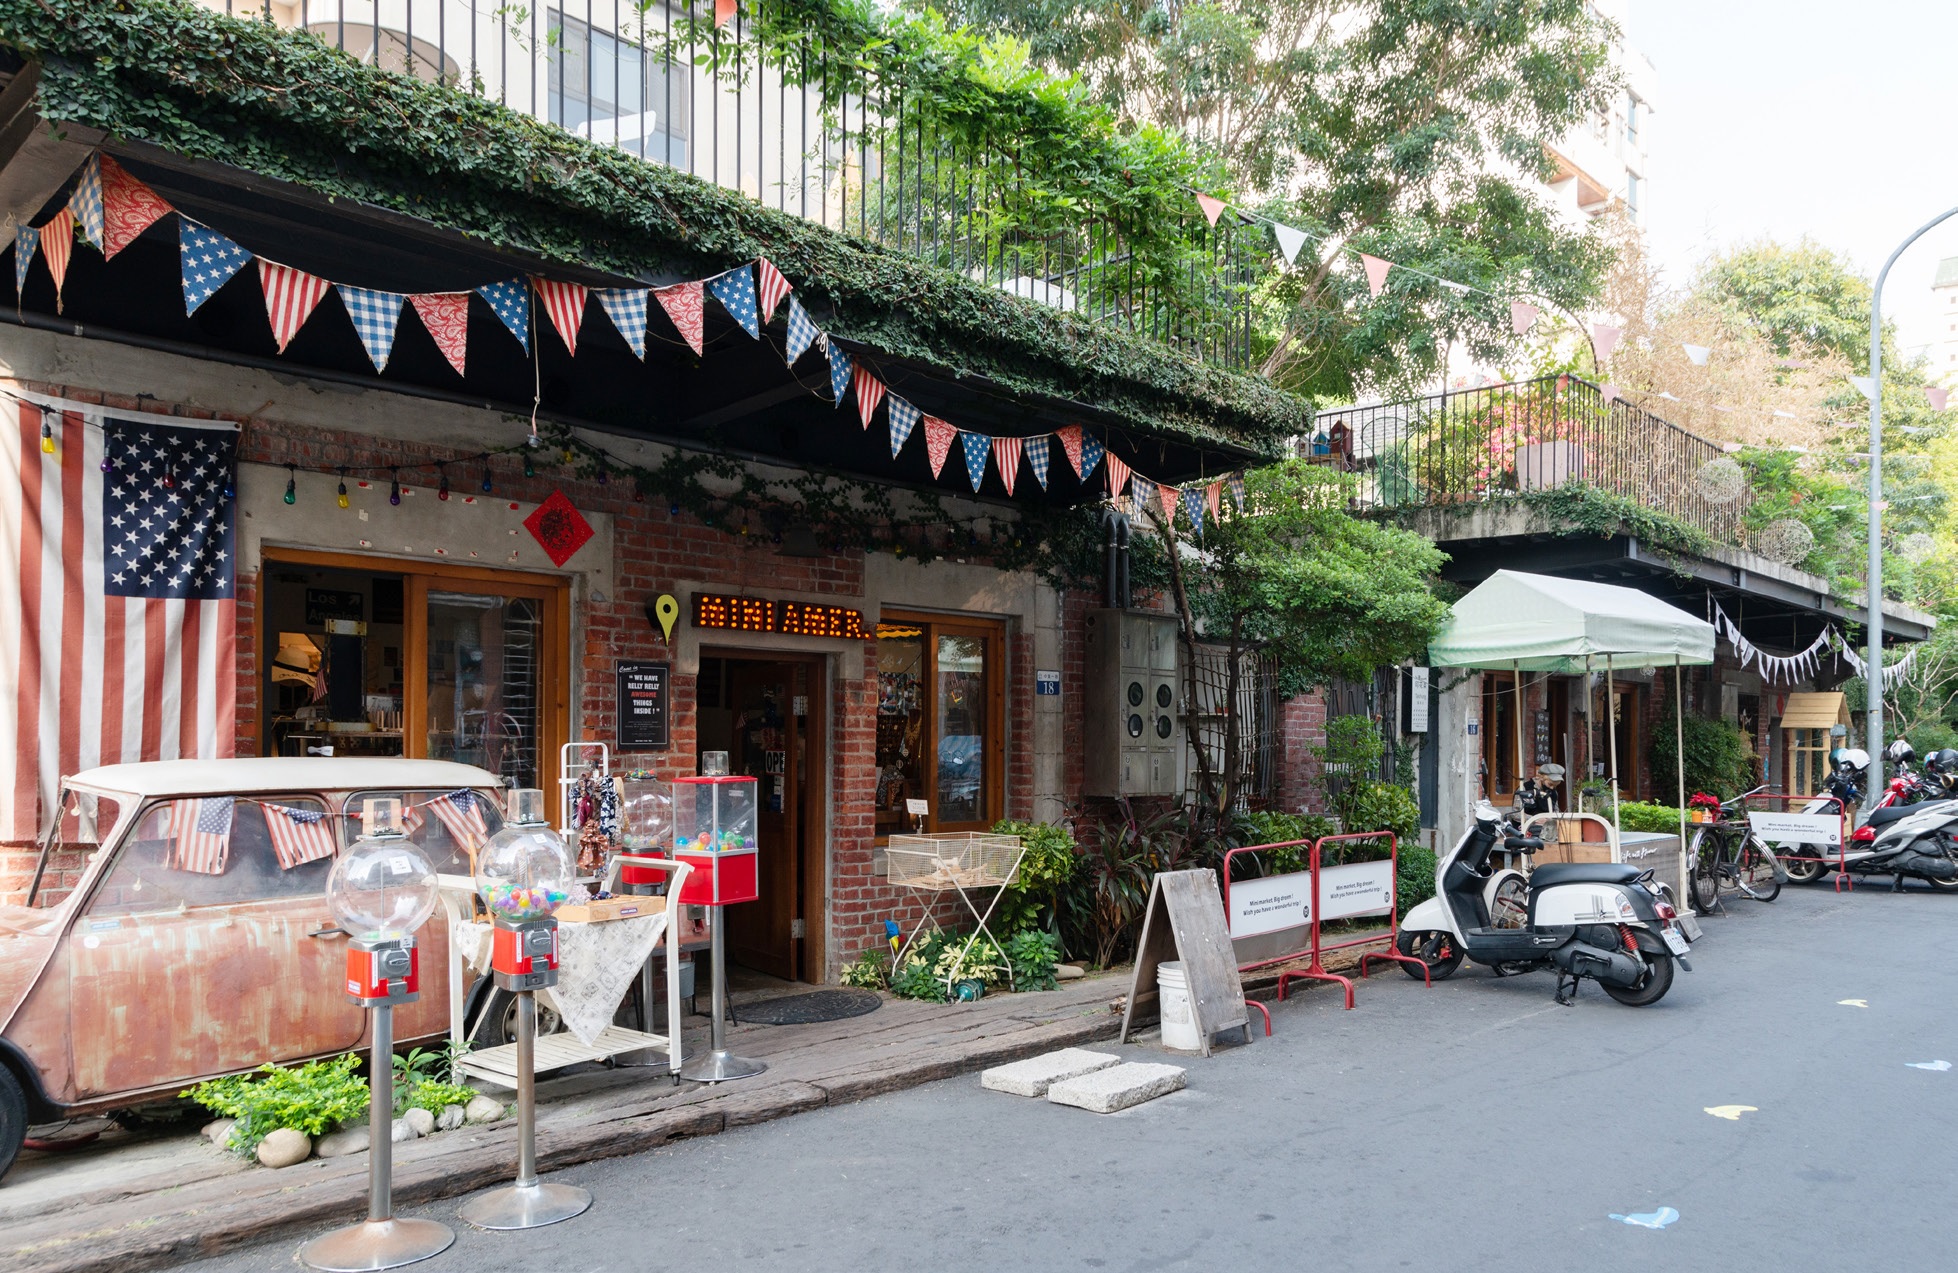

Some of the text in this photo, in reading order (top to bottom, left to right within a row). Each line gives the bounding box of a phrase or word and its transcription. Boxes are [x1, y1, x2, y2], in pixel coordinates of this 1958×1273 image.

[308, 591, 337, 605] Los
[699, 596, 871, 639] MINI AMER.
[619, 665, 632, 673] Come
[628, 682, 643, 690] RELLY
[1043, 682, 1054, 695] 18
[1275, 902, 1292, 910] wonderful
